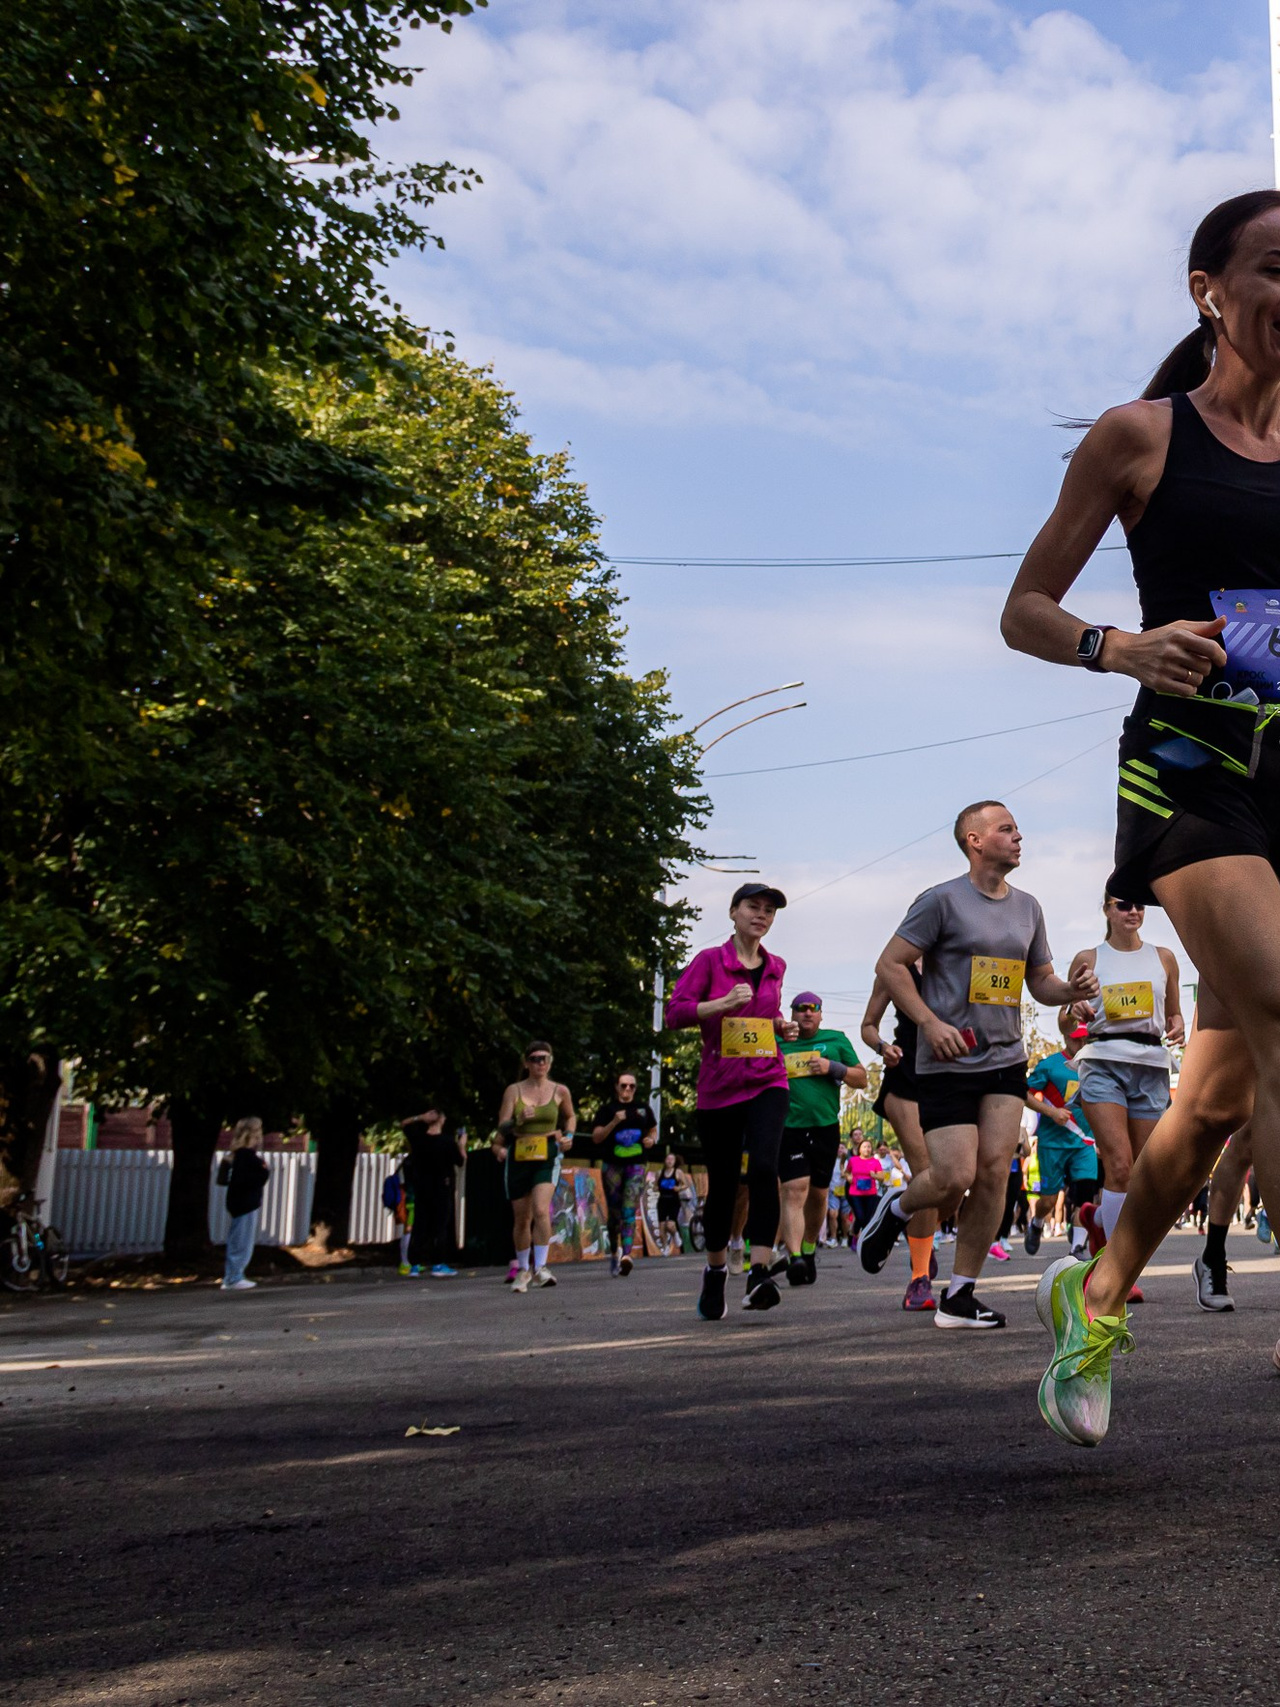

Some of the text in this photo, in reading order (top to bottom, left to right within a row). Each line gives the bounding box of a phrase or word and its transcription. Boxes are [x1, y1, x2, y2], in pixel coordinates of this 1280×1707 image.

[991, 975, 1010, 989] 212
[1121, 995, 1137, 1006] 114
[743, 1032, 758, 1044] 53
